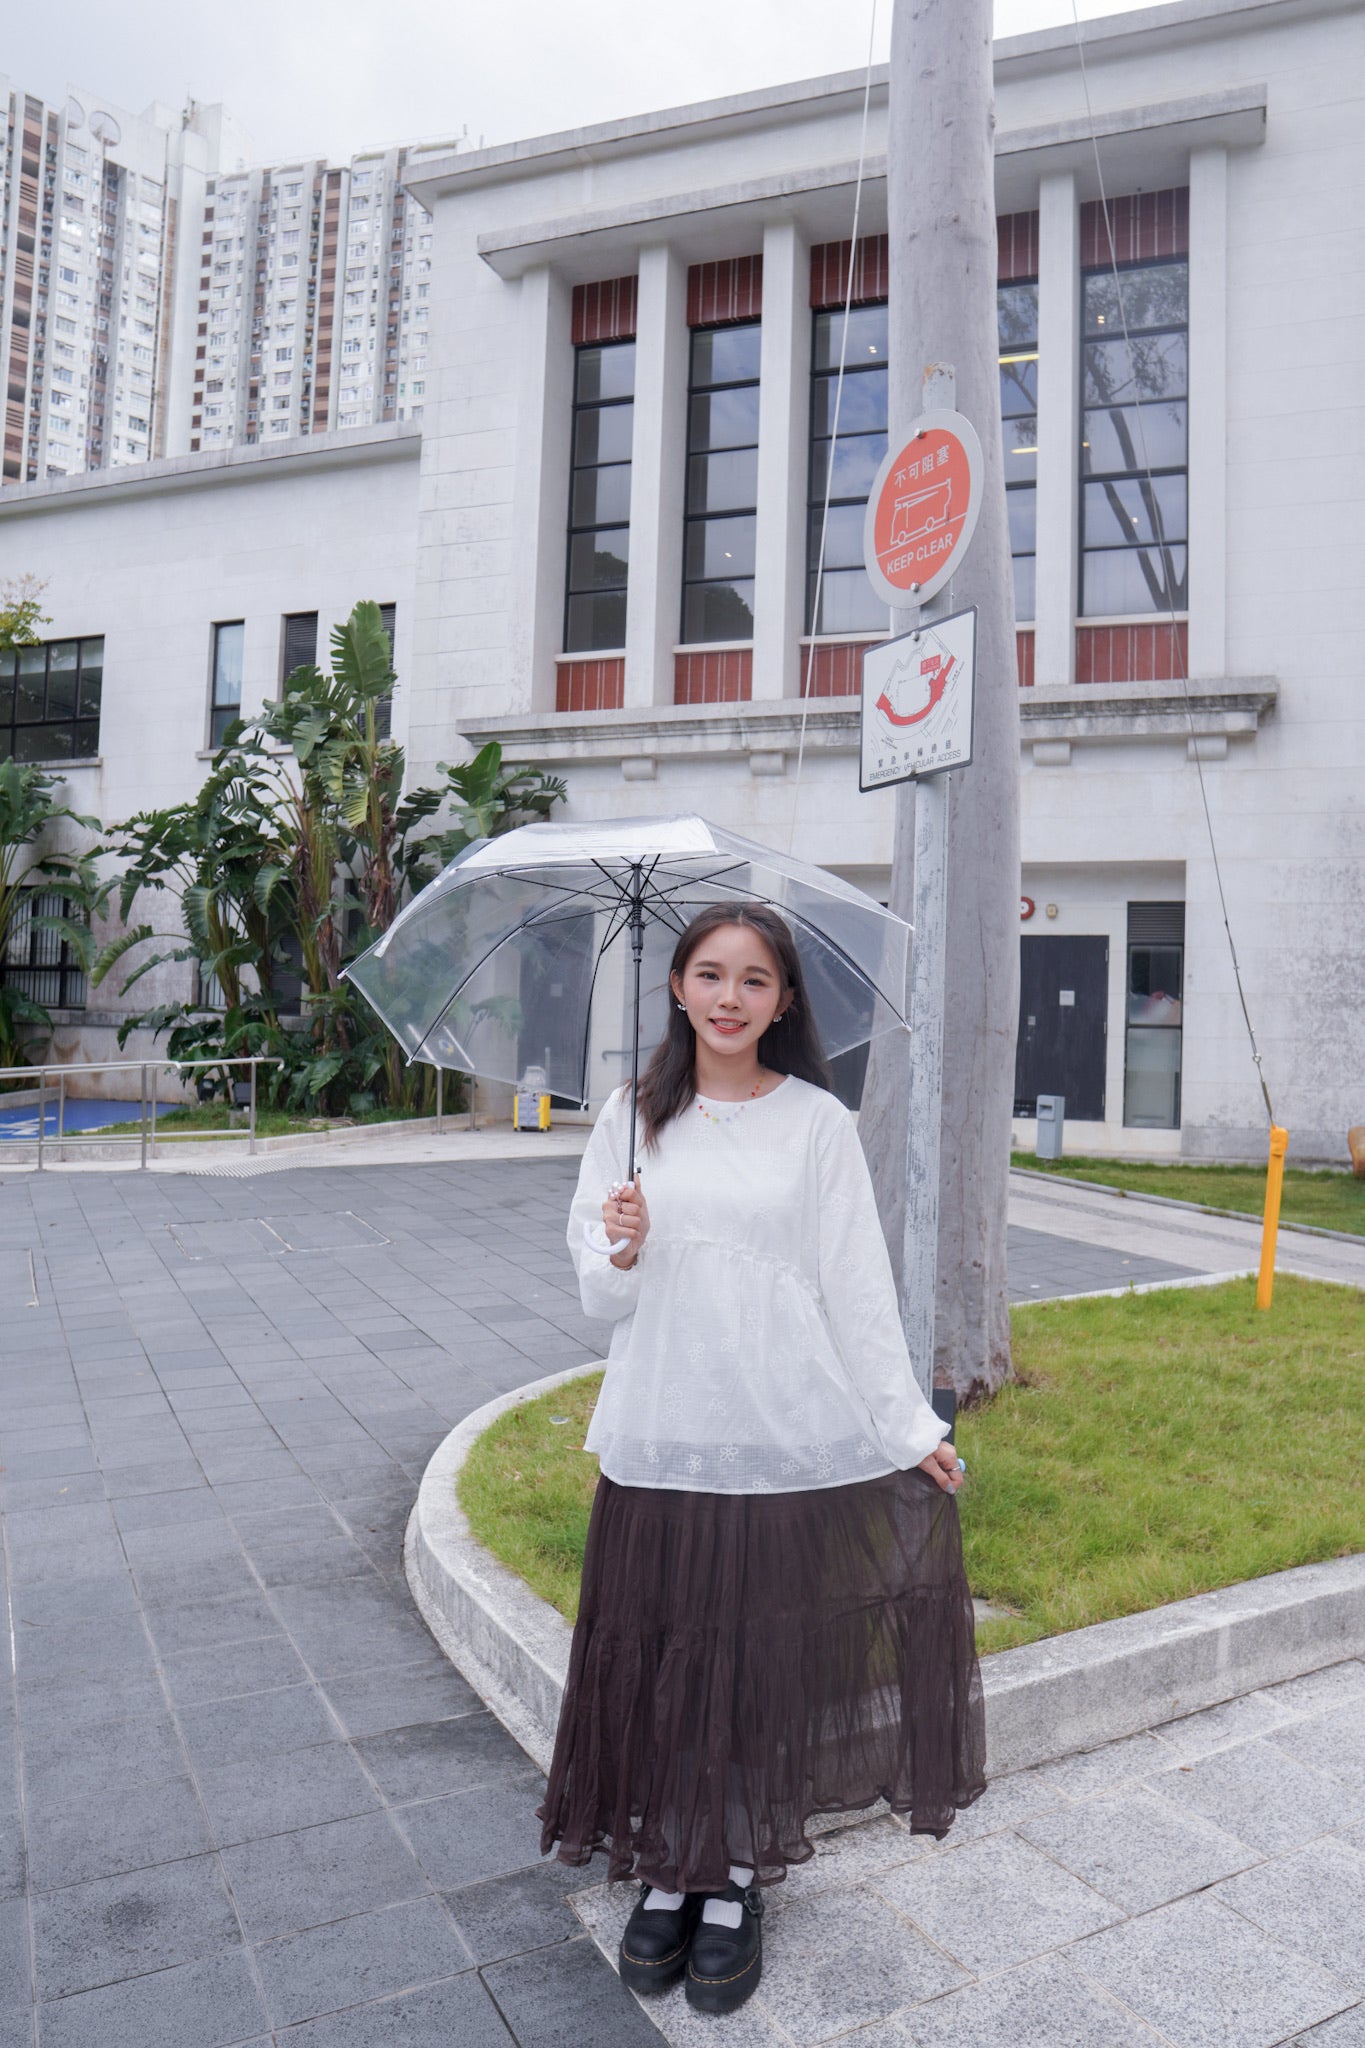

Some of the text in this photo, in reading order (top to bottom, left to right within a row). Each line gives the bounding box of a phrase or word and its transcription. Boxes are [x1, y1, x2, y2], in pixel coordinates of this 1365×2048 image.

[895, 445, 949, 488] 不可阻塞
[887, 533, 952, 575] KEEP CLEAR
[869, 750, 961, 781] EMERGENCY VEHICULAR ACCESS
